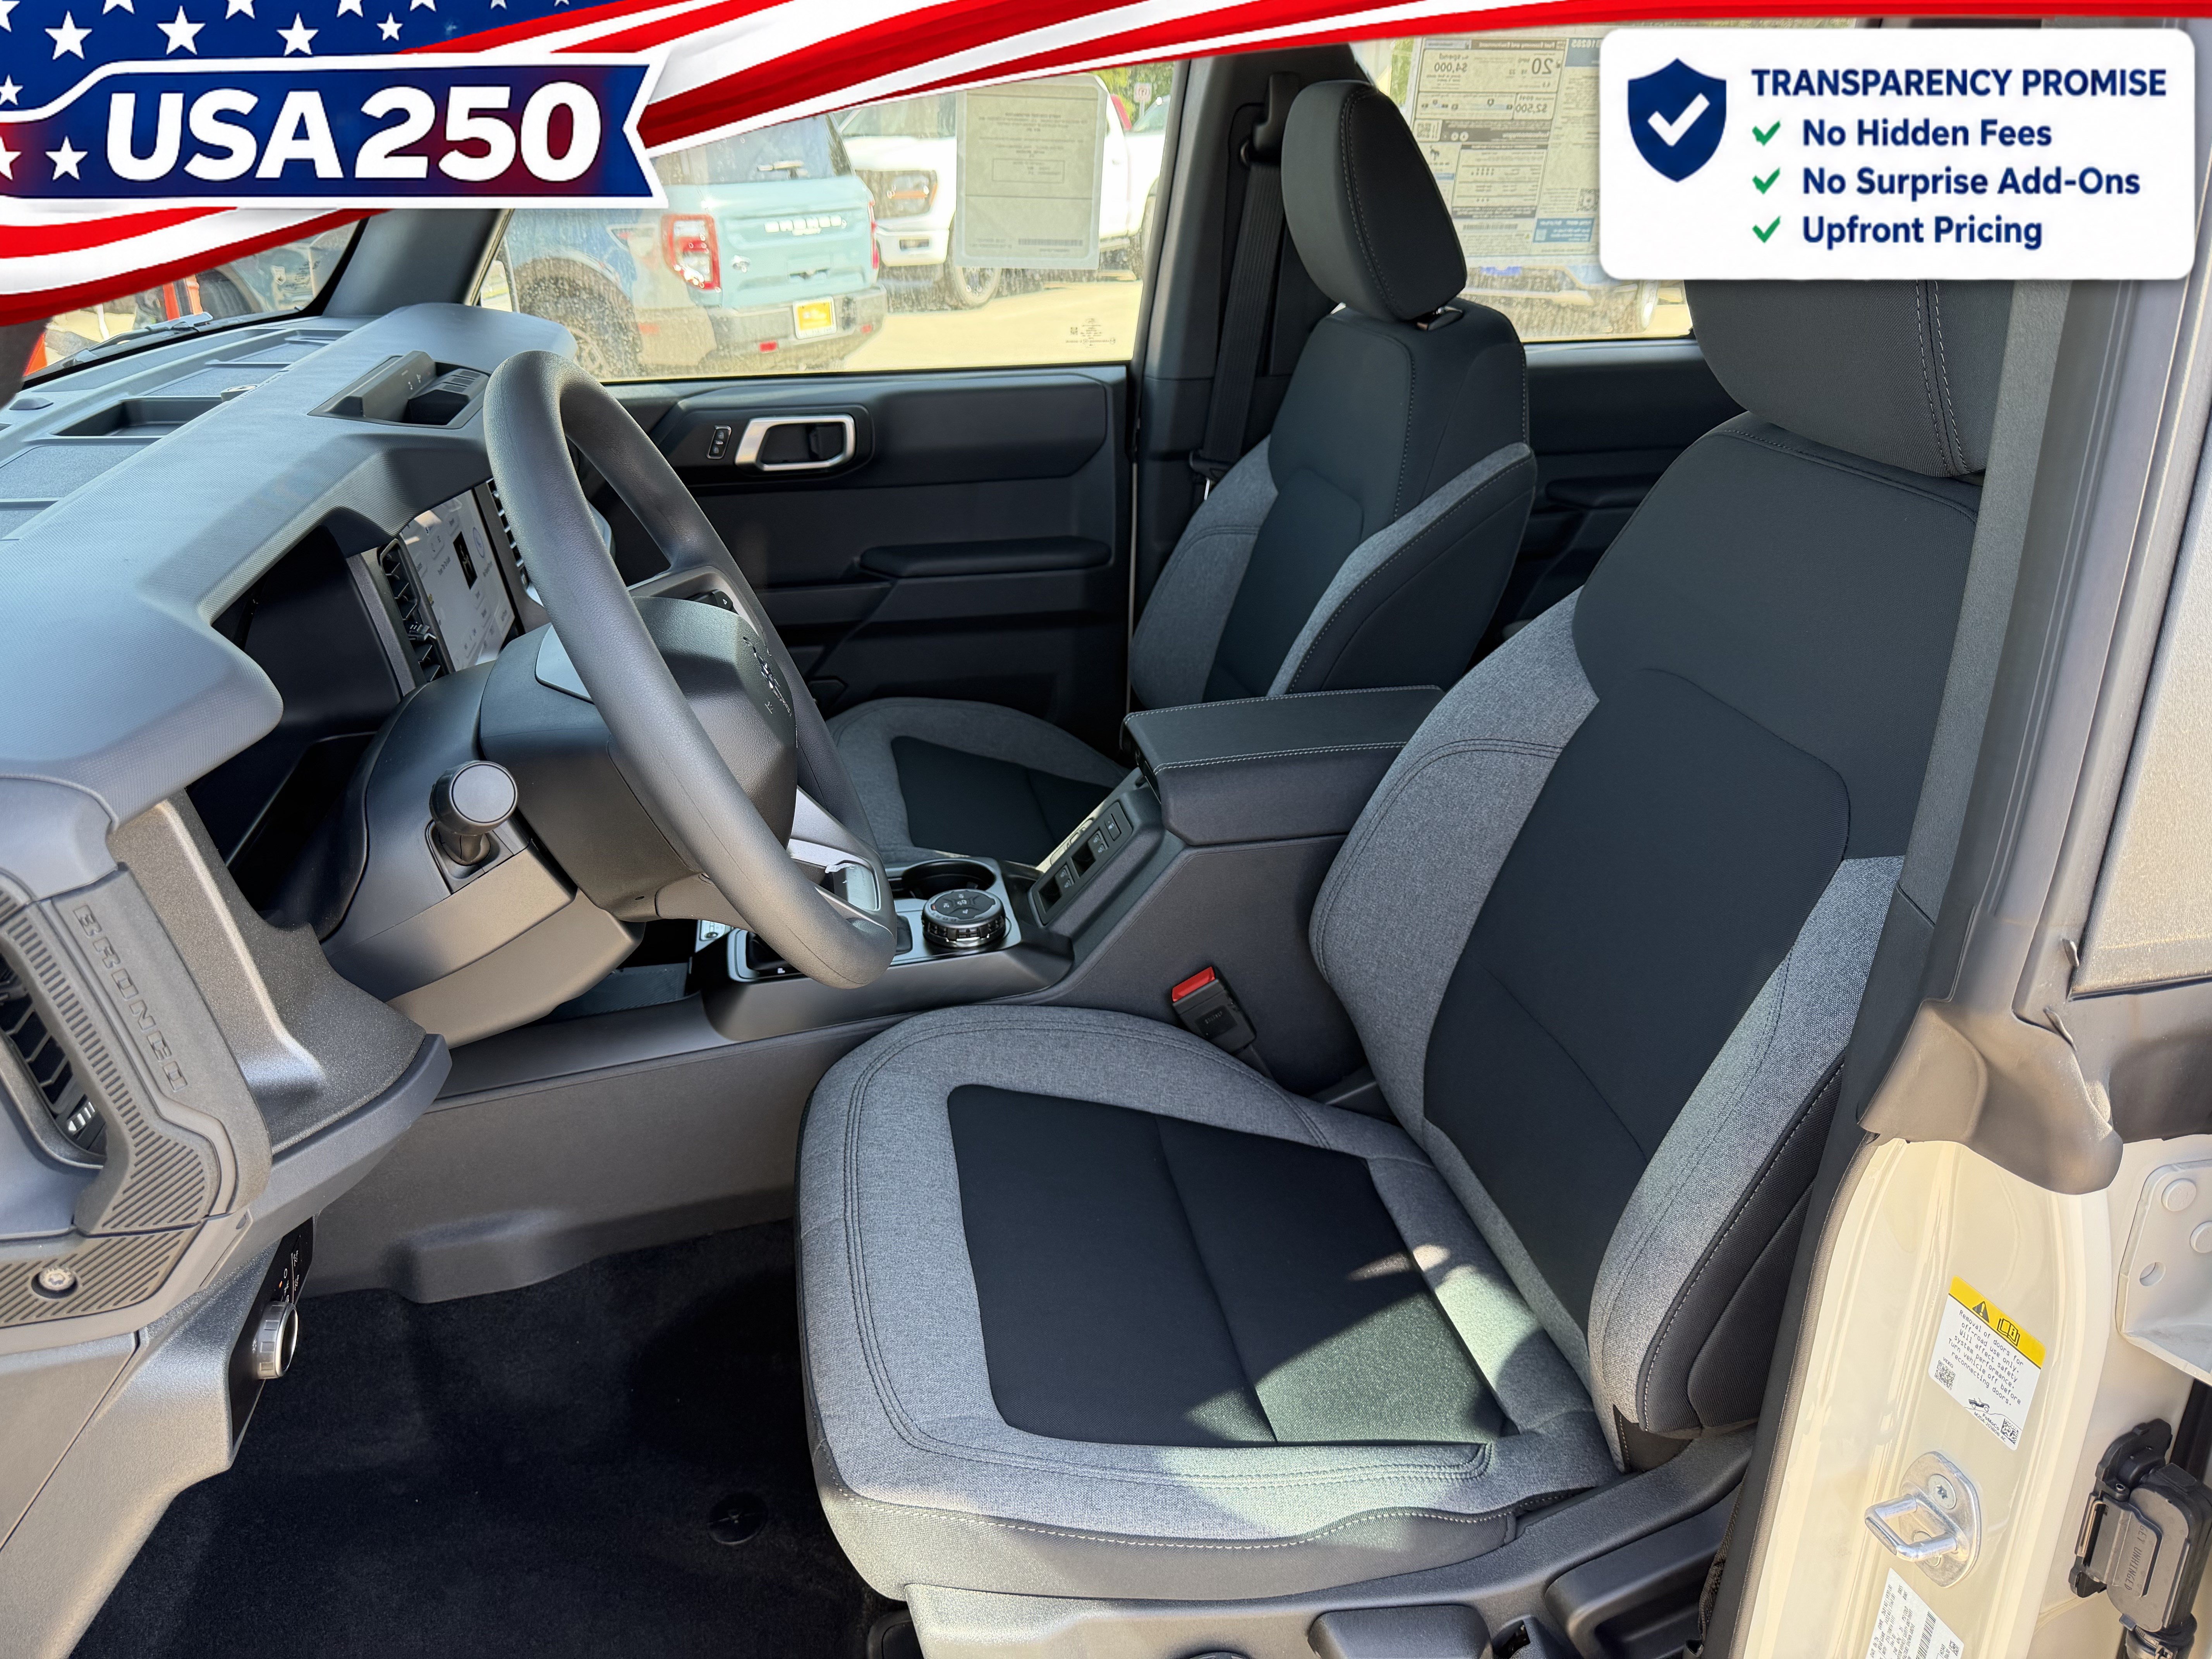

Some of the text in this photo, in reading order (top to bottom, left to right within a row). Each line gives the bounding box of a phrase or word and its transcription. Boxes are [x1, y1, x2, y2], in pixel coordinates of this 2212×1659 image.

[1954, 1335, 2014, 1389] system performance.
[1959, 1310, 1981, 1332] Removal
[1994, 1340, 2010, 1355] doors
[2013, 1355, 2023, 1366] for
[1960, 1329, 2018, 1382] Will affect safety
[1962, 1322, 2020, 1373] off-road use only.
[1948, 1338, 2021, 1405] Turn vehicle off before
[1952, 1352, 2012, 1406] reconnecting doors.
[2124, 1525, 2148, 1590] GET UNHINGED
